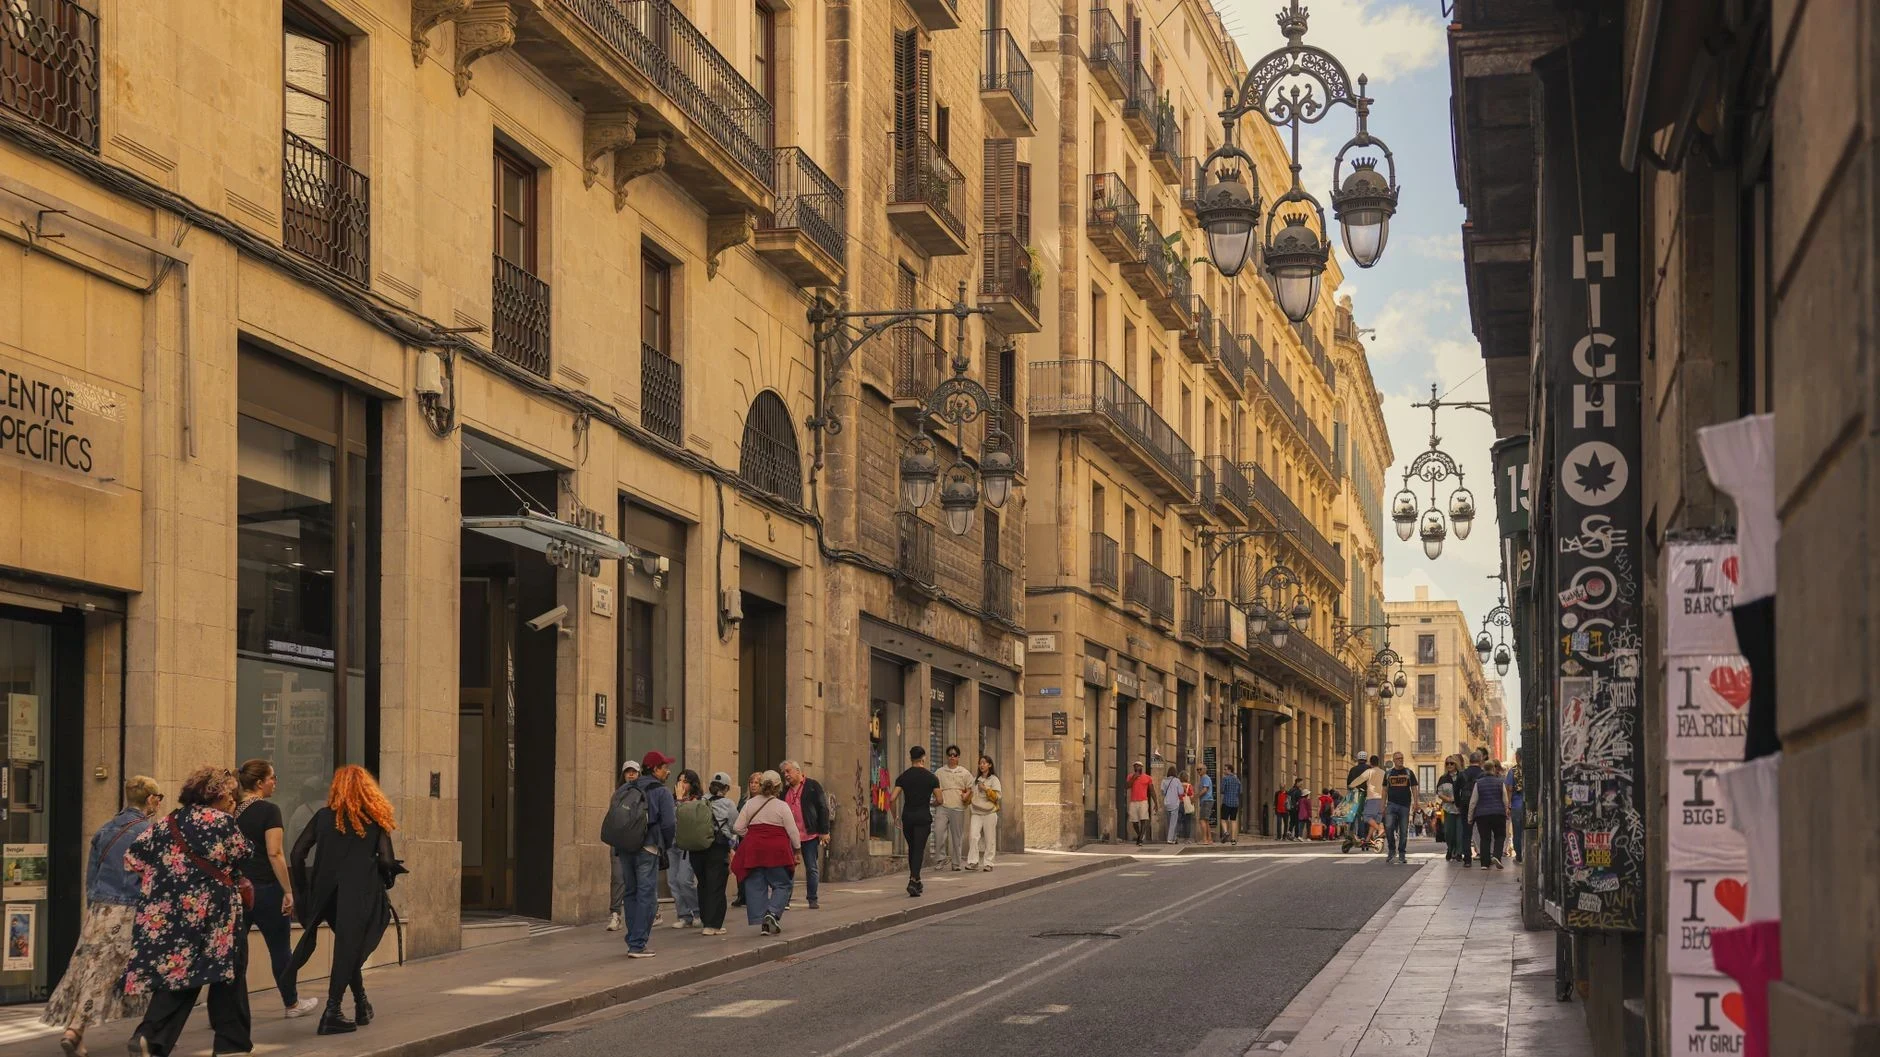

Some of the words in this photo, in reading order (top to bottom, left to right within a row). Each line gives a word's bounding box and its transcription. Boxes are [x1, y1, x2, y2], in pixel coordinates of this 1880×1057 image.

[1572, 233, 1616, 428] HIGH
[1677, 666, 1701, 711] I
[1683, 768, 1717, 807] I
[1683, 808, 1713, 825] BIG
[1682, 878, 1706, 922] I
[1695, 991, 1720, 1031] I
[1688, 1034, 1707, 1053] MY
